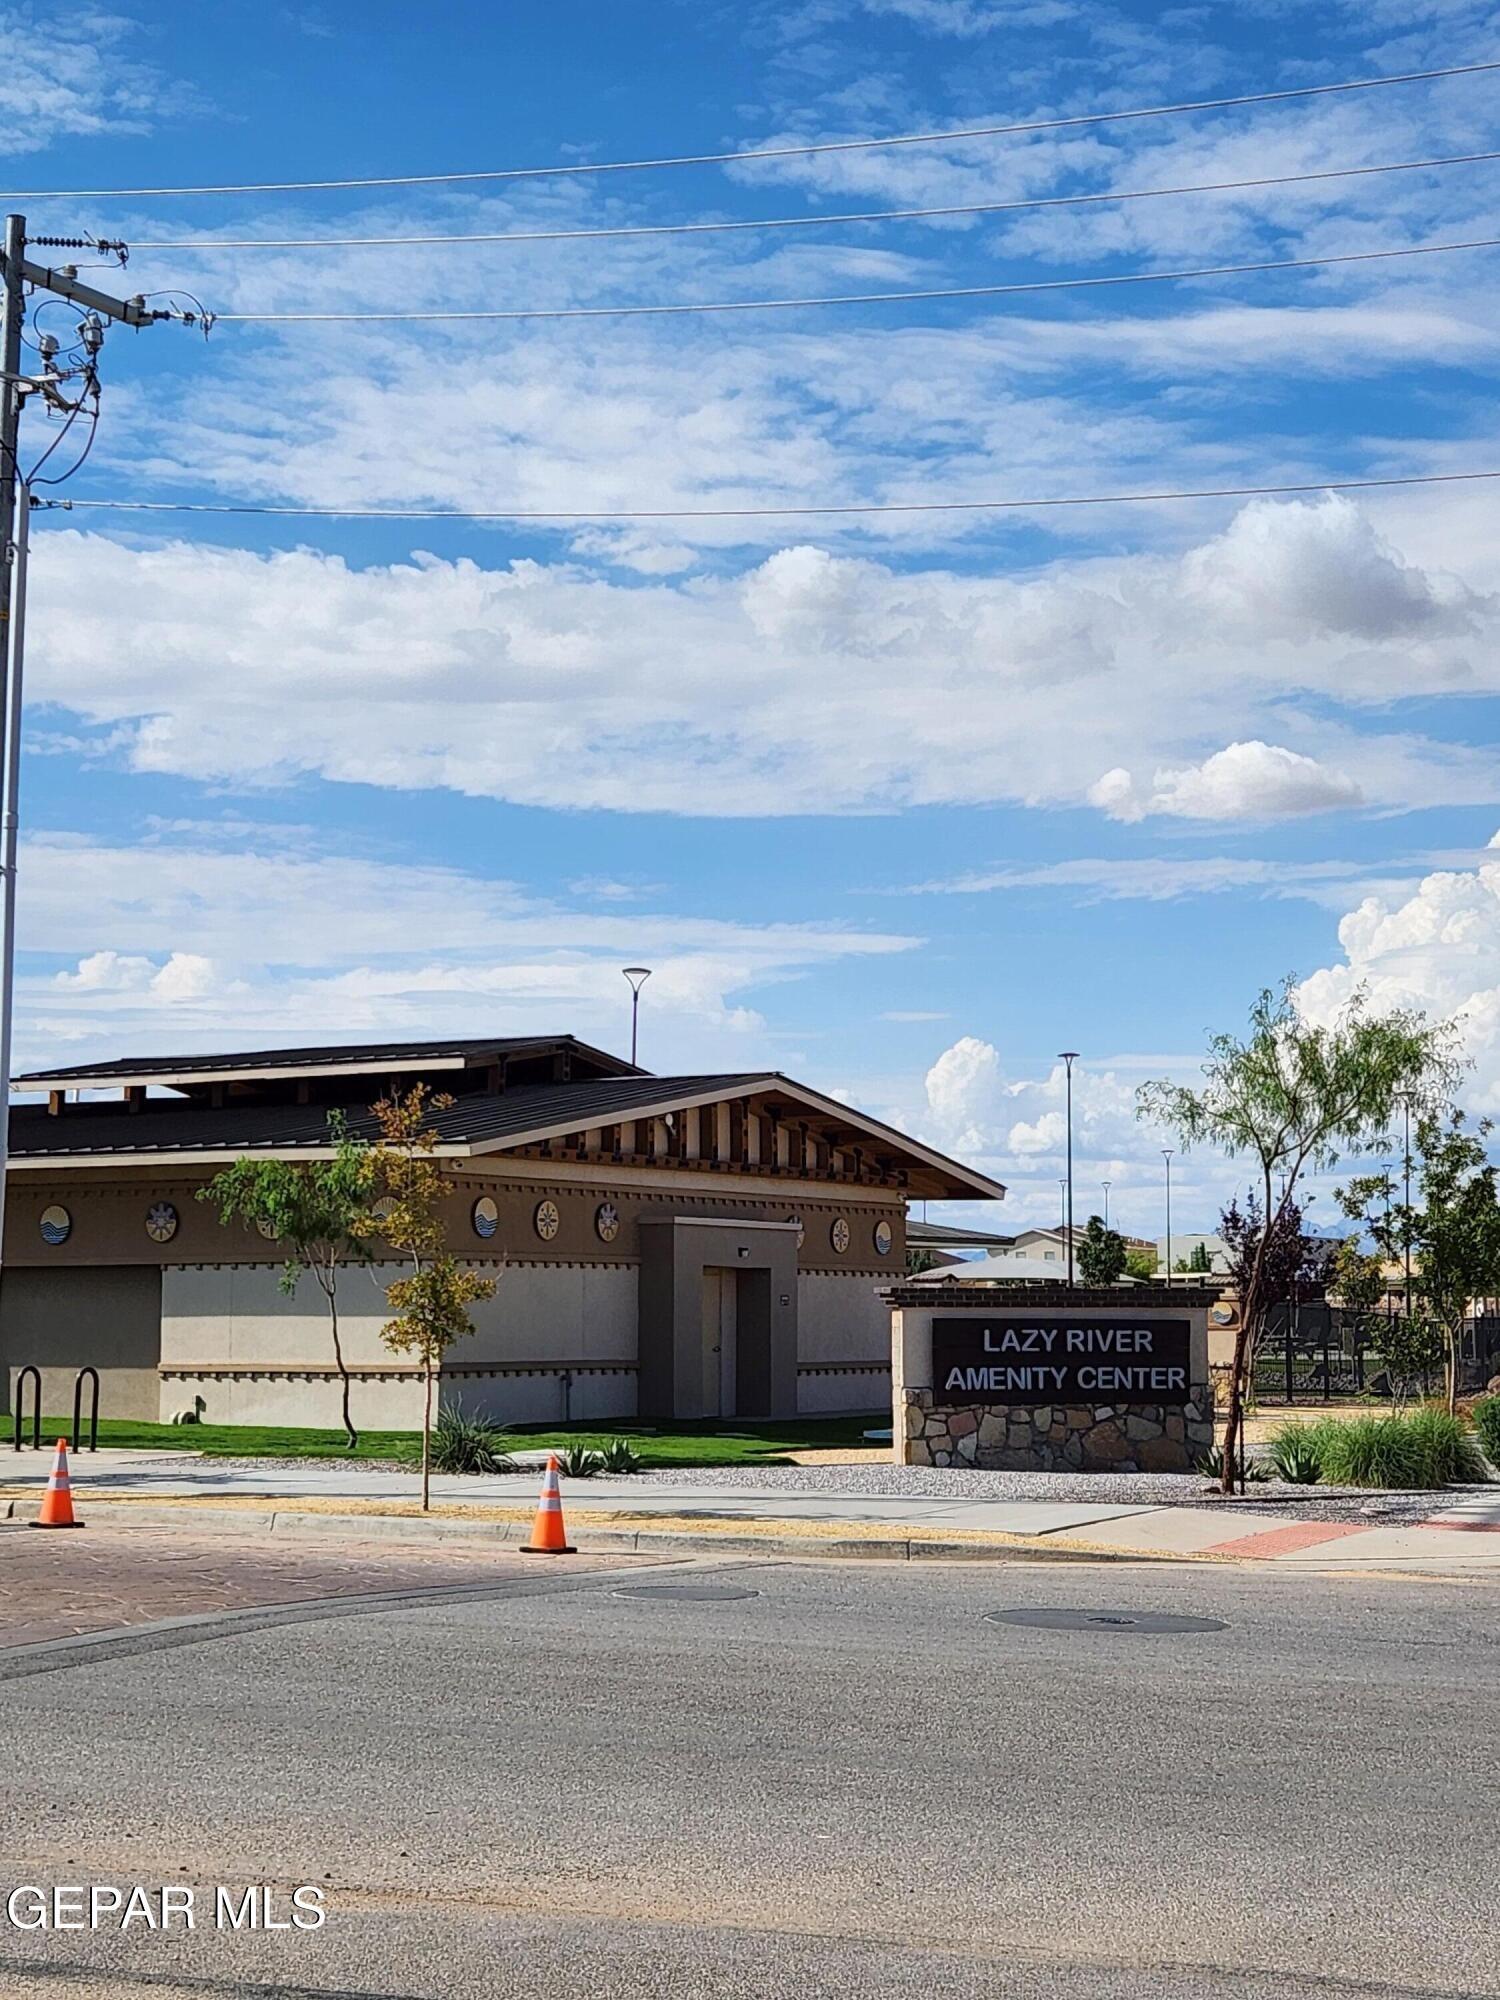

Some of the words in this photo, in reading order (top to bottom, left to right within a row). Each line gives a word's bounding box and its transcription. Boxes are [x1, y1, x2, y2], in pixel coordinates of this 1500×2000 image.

[983, 1329, 1058, 1352] LAZY
[1066, 1329, 1154, 1353] RIVER
[945, 1366, 1068, 1390] AMENITY
[1076, 1366, 1186, 1390] CENTER
